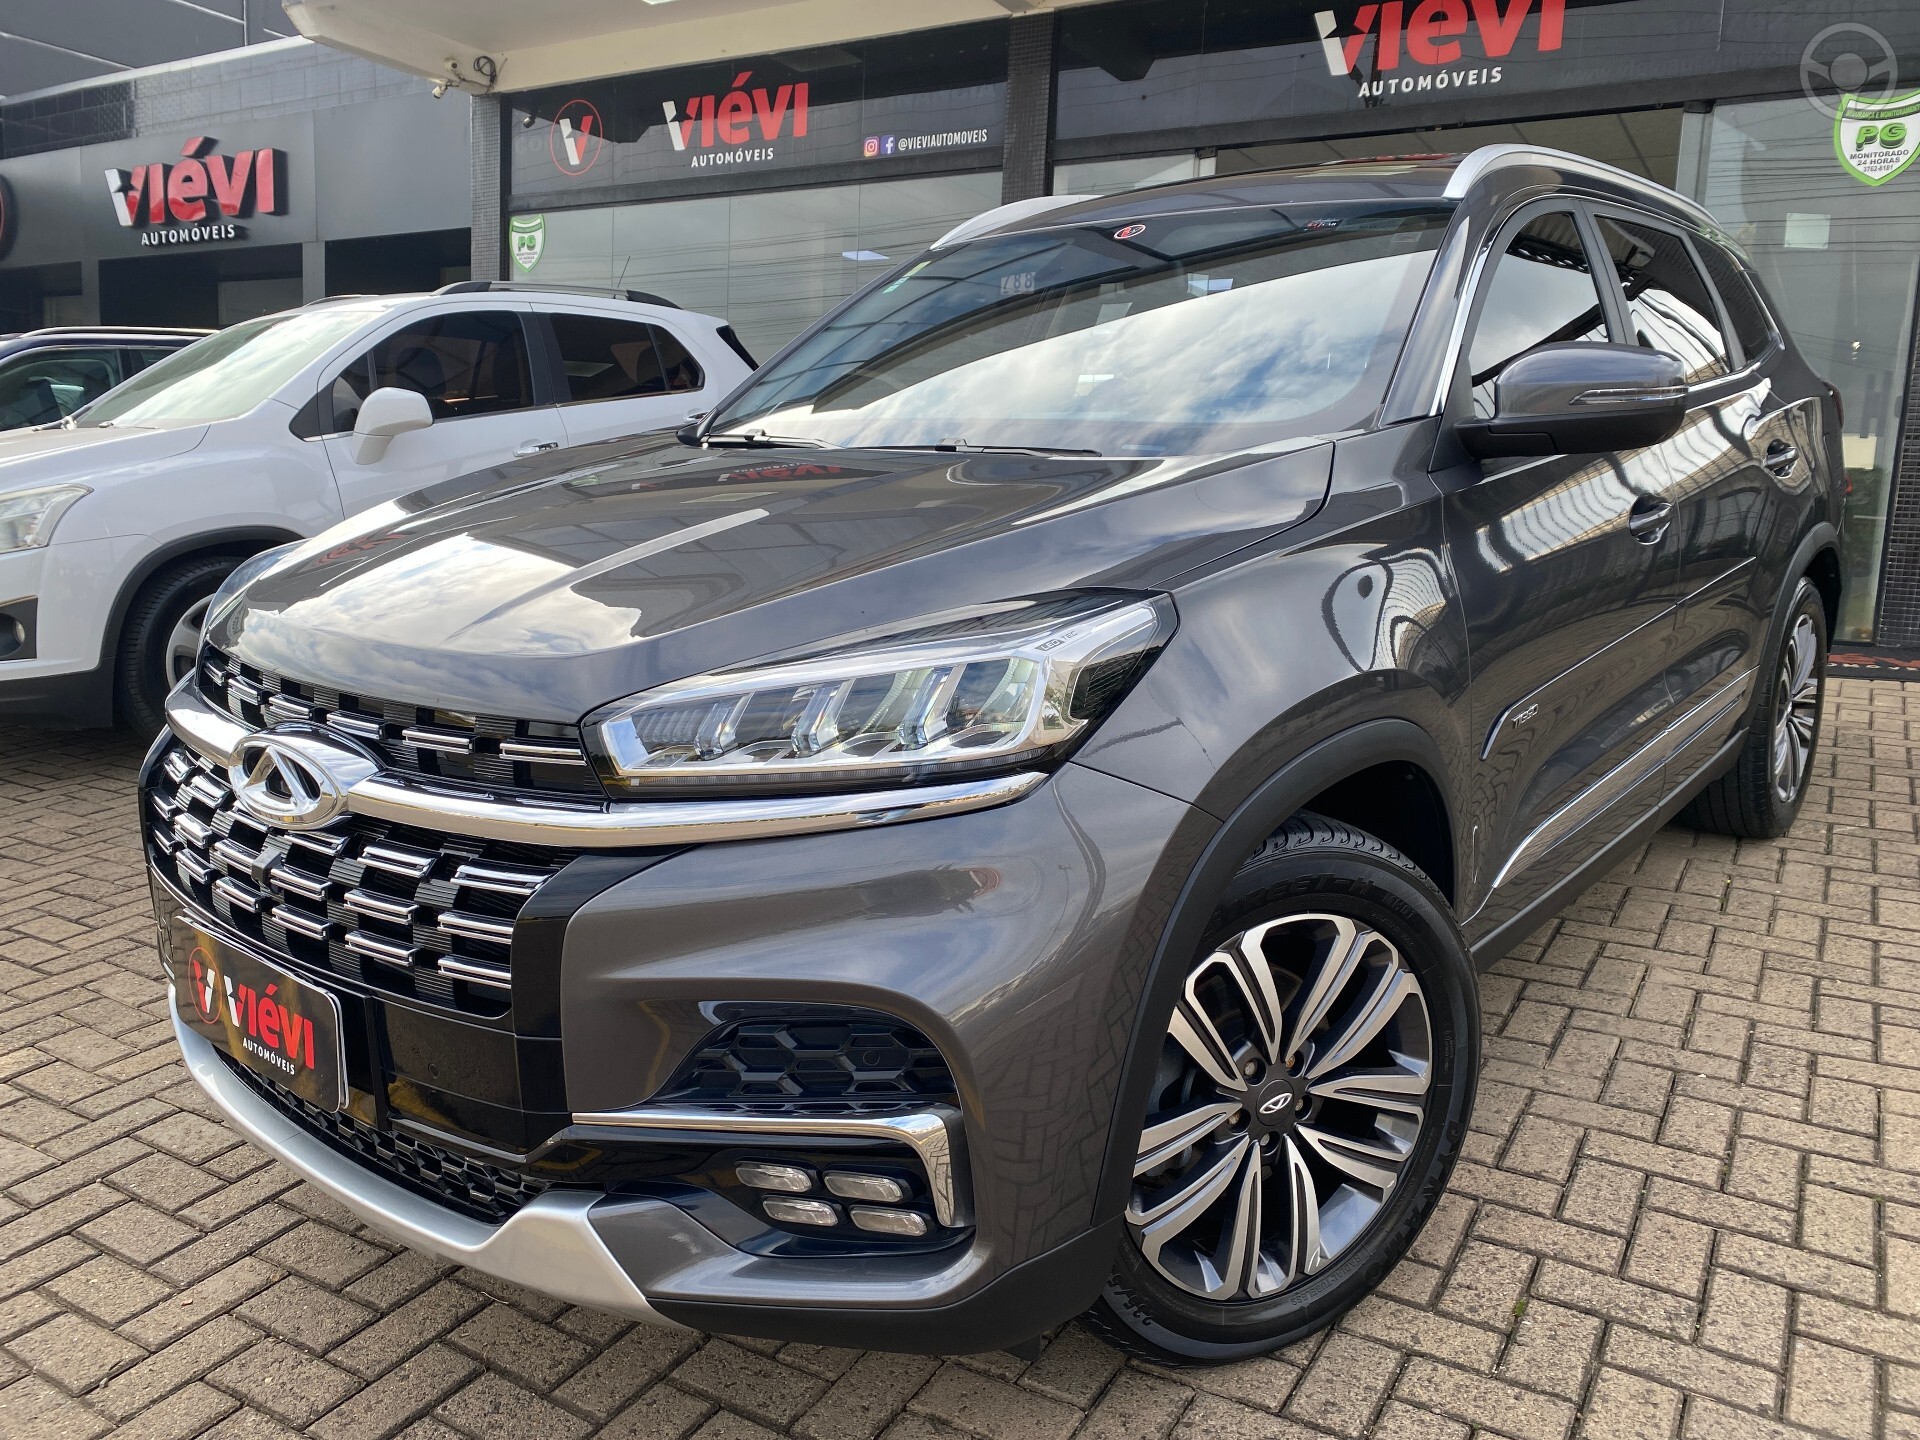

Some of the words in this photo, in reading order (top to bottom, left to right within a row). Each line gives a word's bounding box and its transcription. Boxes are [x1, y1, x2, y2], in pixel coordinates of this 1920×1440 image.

[1358, 66, 1502, 98] AUTOMÓVEIS
[1880, 104, 1920, 117] MONITORAMENT
[898, 129, 988, 150] @VIEVIAUTOMOVEIS
[1856, 122, 1907, 151] PG
[691, 147, 774, 168] AUTOMÓVEIS
[1850, 150, 1909, 159] MONITORADO
[1870, 157, 1901, 165] HORAS
[141, 222, 236, 245] AUTOMÓVEIS
[242, 1037, 296, 1076] AUTOMÓVEIS
